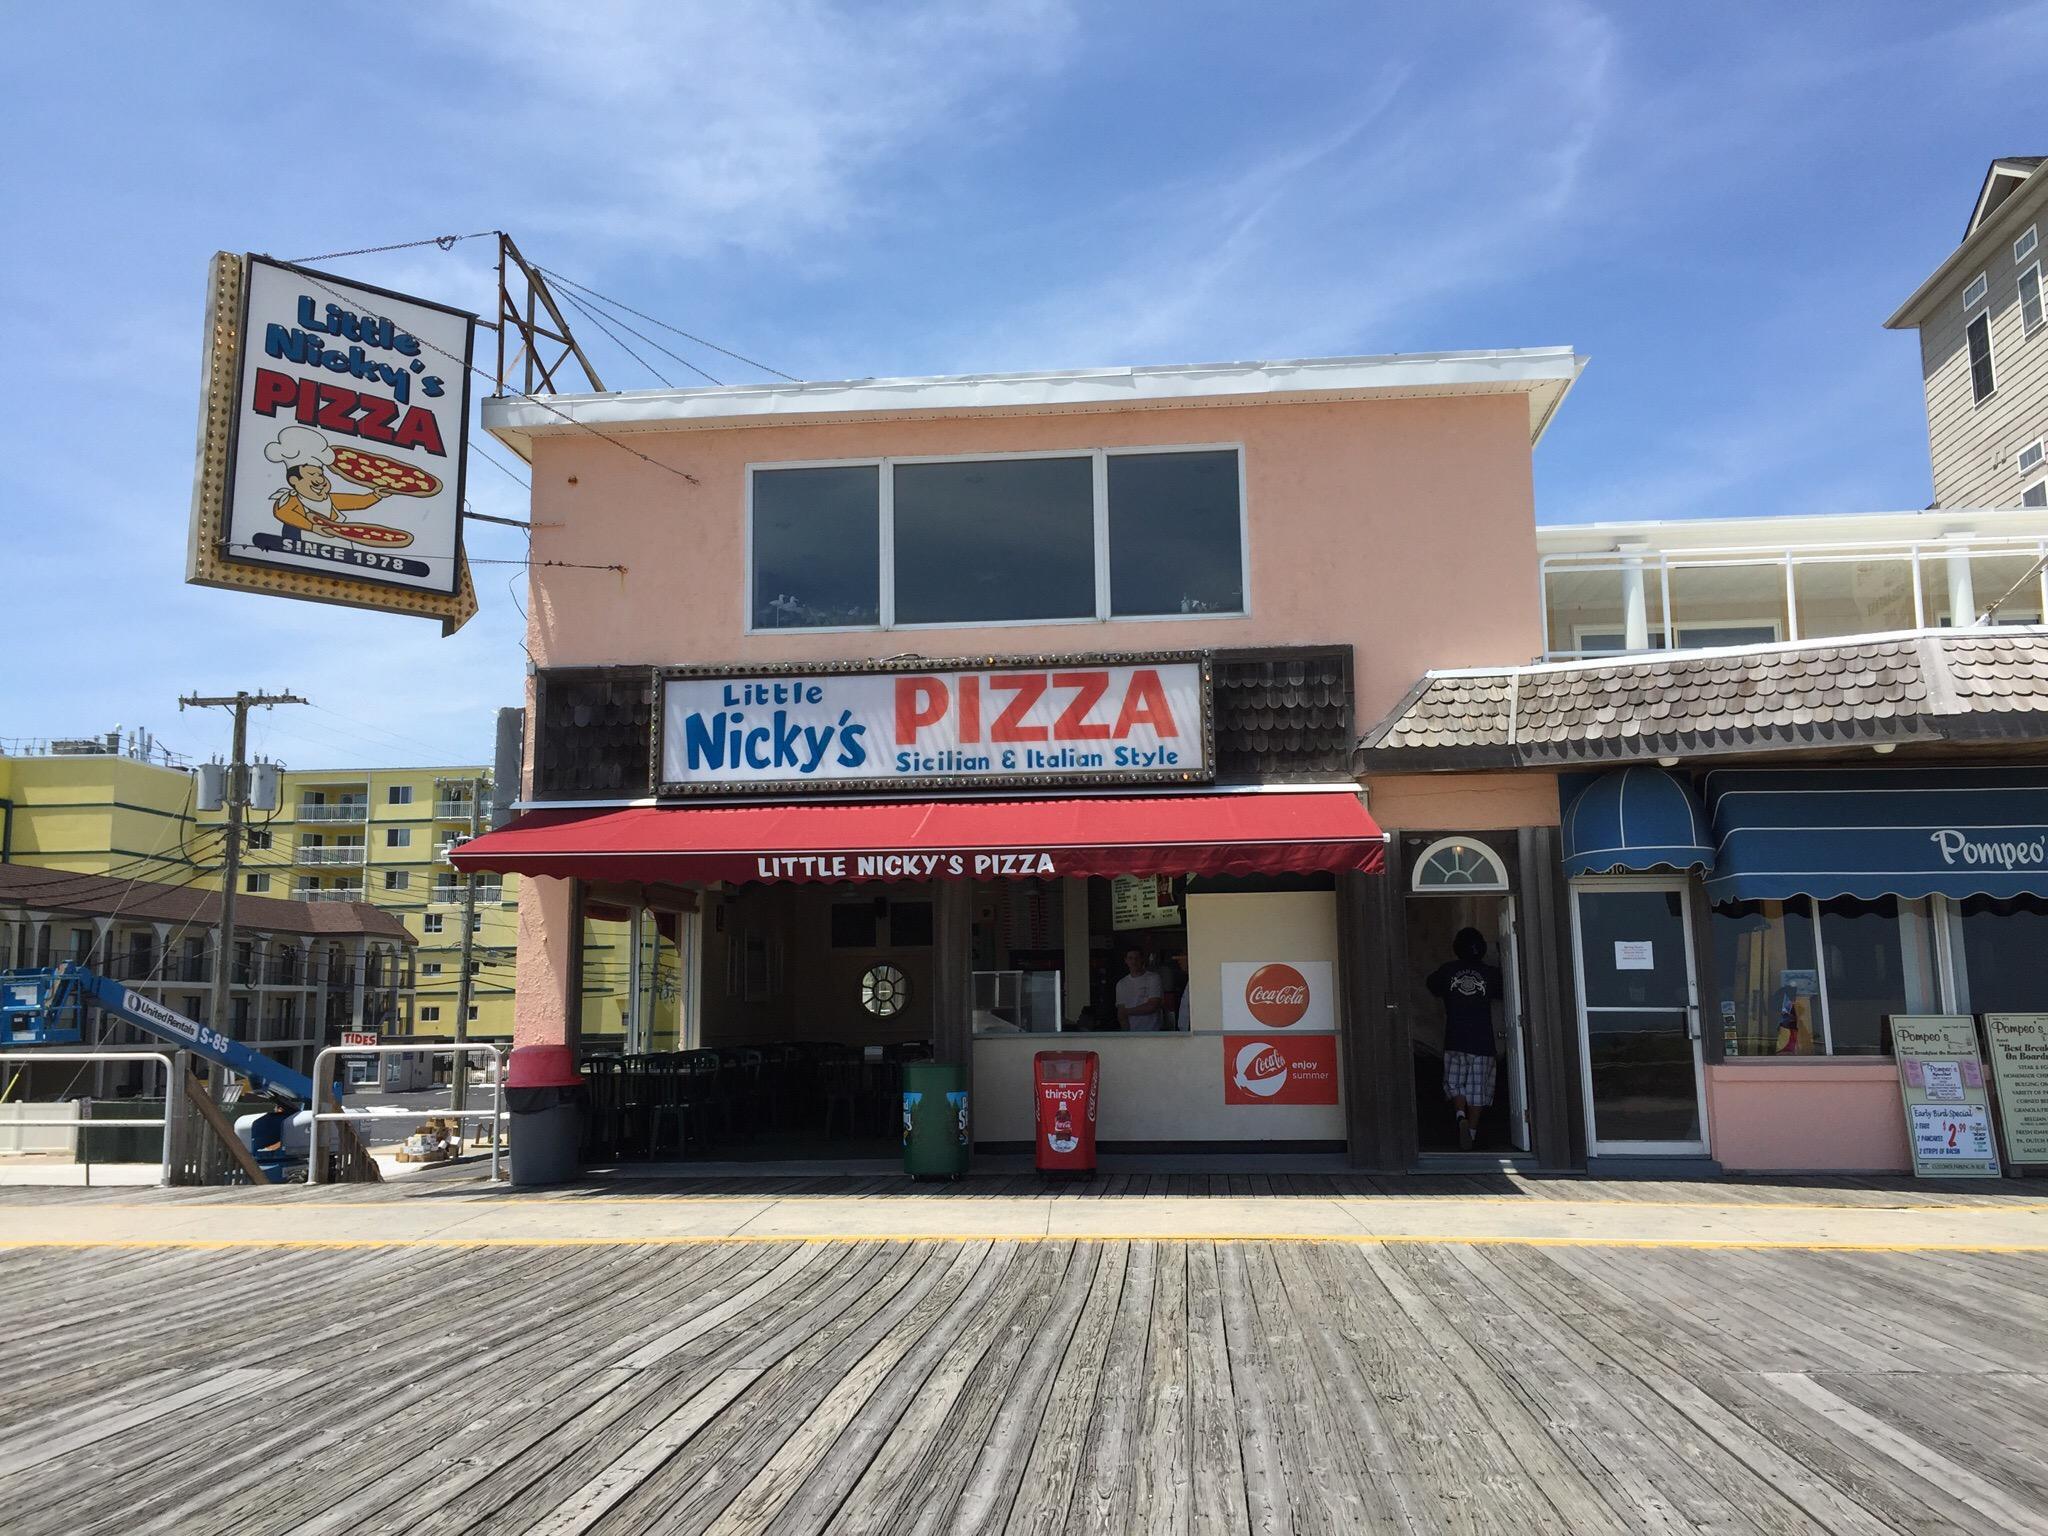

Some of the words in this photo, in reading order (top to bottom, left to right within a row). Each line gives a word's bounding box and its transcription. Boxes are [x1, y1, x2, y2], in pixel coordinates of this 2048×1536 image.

[298, 295, 421, 356] Little
[265, 323, 445, 403] Nicky's
[253, 368, 447, 457] PIZZA
[282, 538, 345, 561] SINCE
[353, 552, 405, 572] 1978
[723, 682, 823, 707] Little
[894, 670, 1178, 745] PIZZA
[685, 709, 866, 774] Nicky's
[896, 750, 990, 773] Sicilian
[1001, 749, 1016, 769] &
[1027, 748, 1103, 769] Italian
[1115, 745, 1178, 768] Style
[757, 855, 846, 878] LITTLE
[857, 853, 964, 876] NICKY'S
[975, 852, 1056, 875] PIZZA
[1250, 985, 1304, 1005] Coca-Cola
[141, 1002, 168, 1023] United
[167, 1014, 196, 1036] Rentals
[200, 1027, 229, 1054] S-85
[344, 1033, 376, 1045] TIDES
[1292, 1061, 1317, 1070] enjoy
[1045, 1089, 1084, 1101] thirsty?
[1914, 1109, 1931, 1119] Early
[1949, 1109, 1973, 1119] Special
